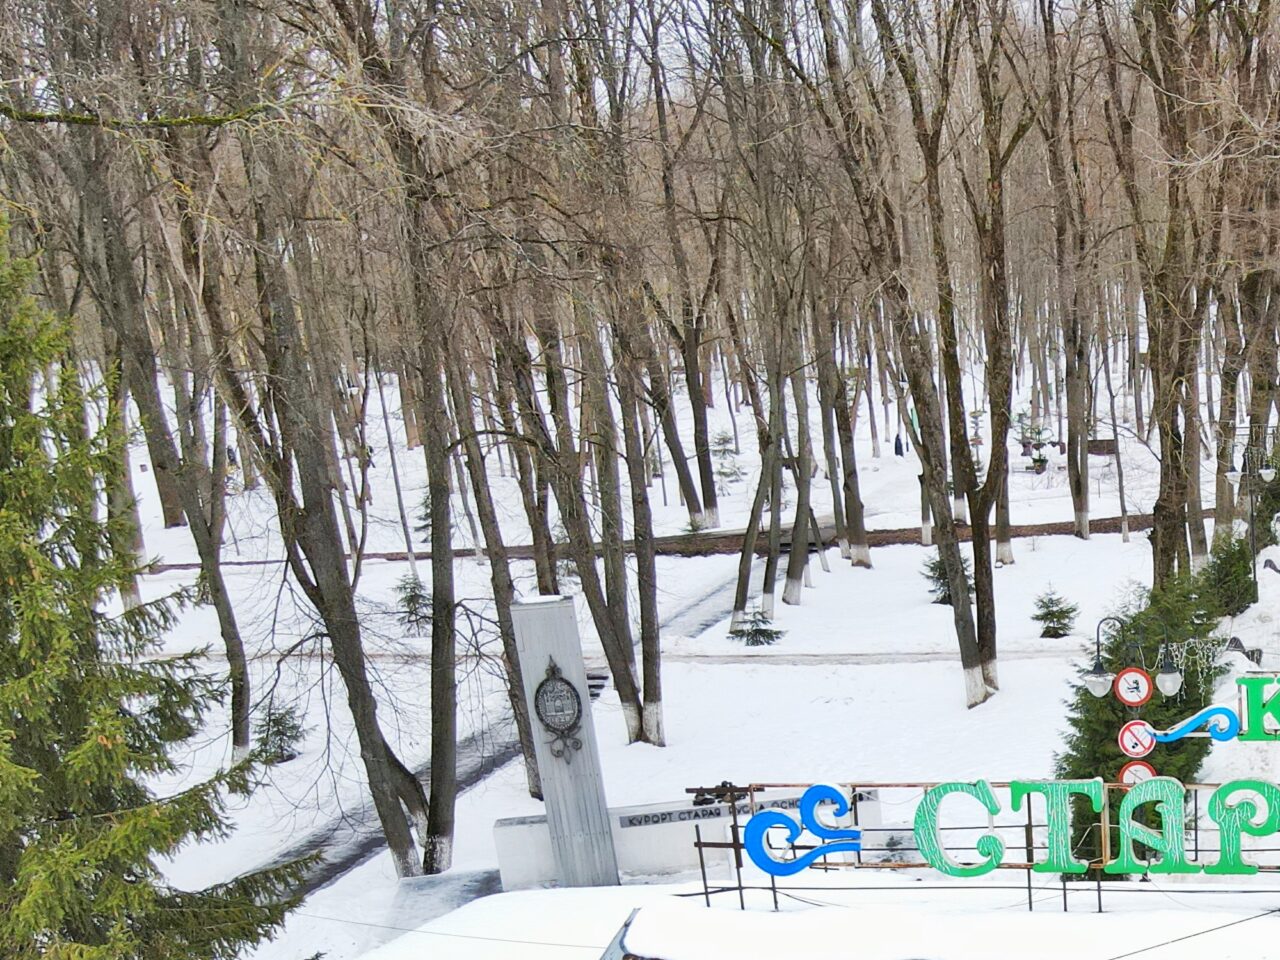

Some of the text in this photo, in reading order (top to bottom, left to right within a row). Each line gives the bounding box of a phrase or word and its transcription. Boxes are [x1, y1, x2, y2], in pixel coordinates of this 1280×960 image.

[628, 812, 674, 827] КУРОРТ
[678, 807, 722, 821] СТАРАЯ
[728, 803, 766, 815] РУСА
